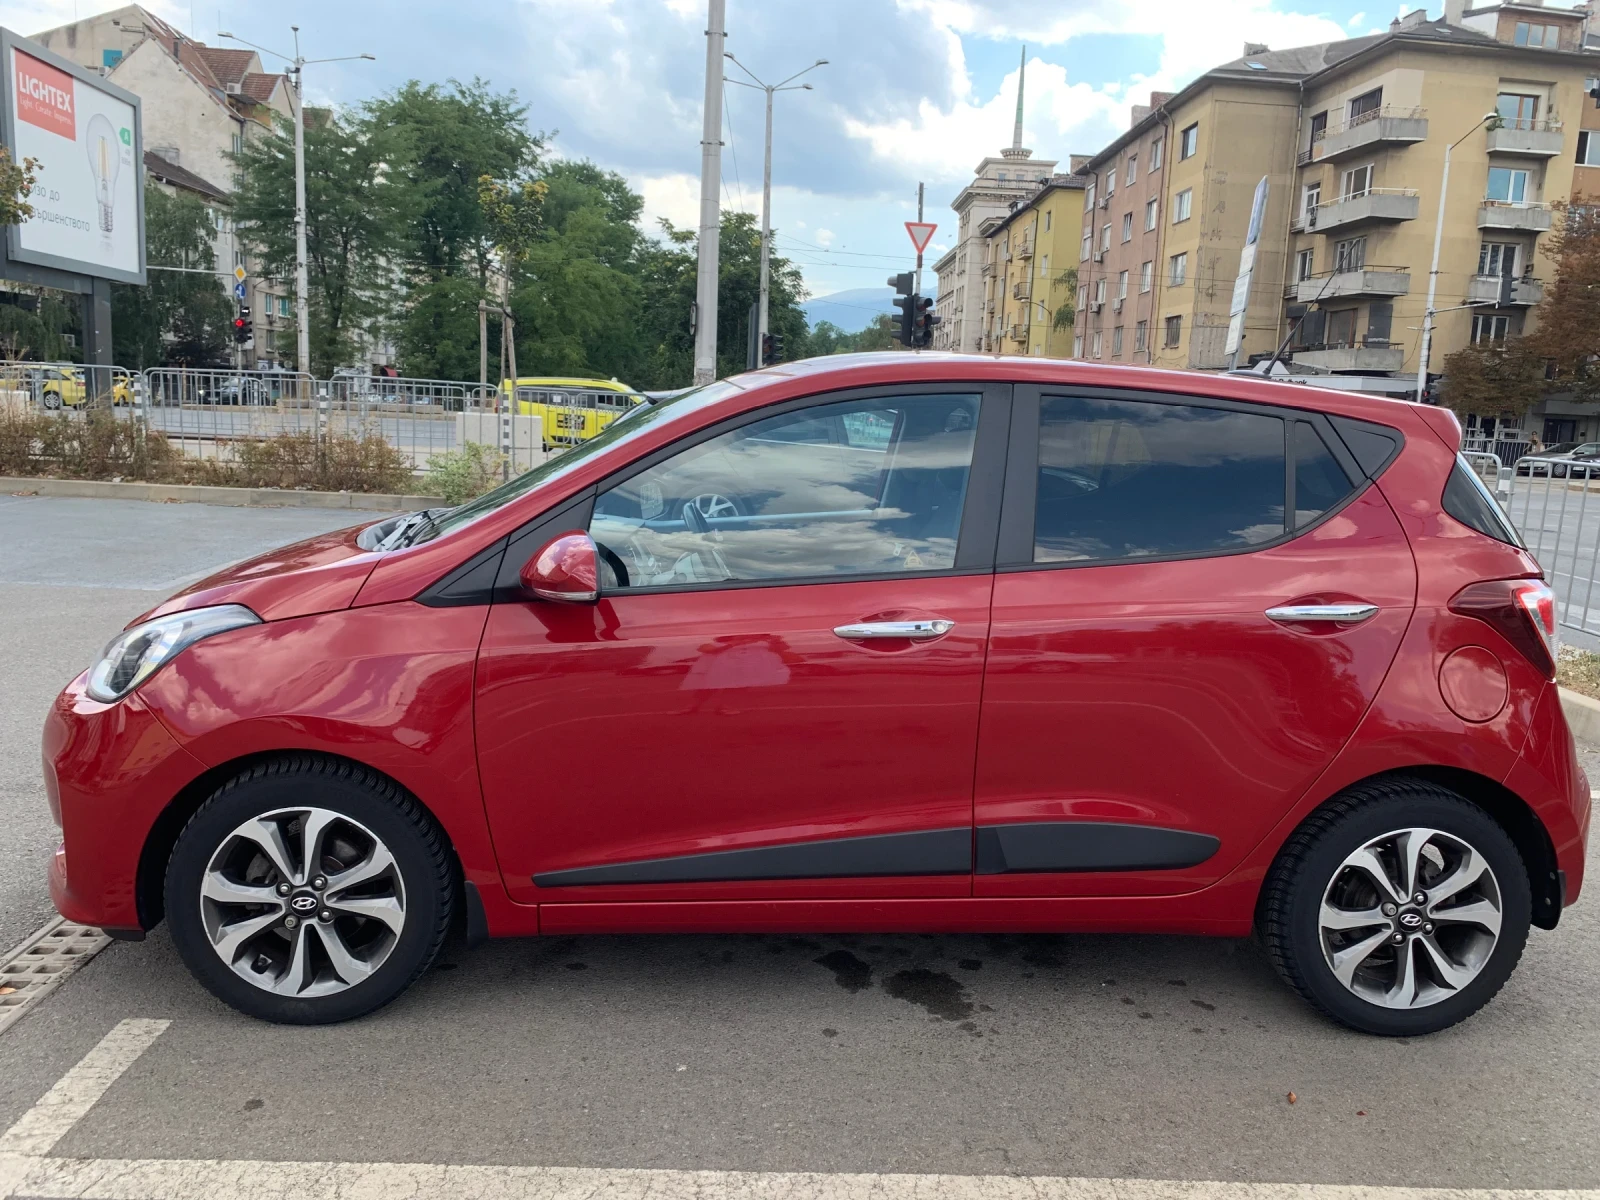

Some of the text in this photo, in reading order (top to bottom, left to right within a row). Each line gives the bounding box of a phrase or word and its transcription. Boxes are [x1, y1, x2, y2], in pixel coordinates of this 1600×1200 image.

[19, 71, 72, 113] LIGHTEX
[31, 184, 46, 198] изо
[33, 207, 91, 232] вършенството
